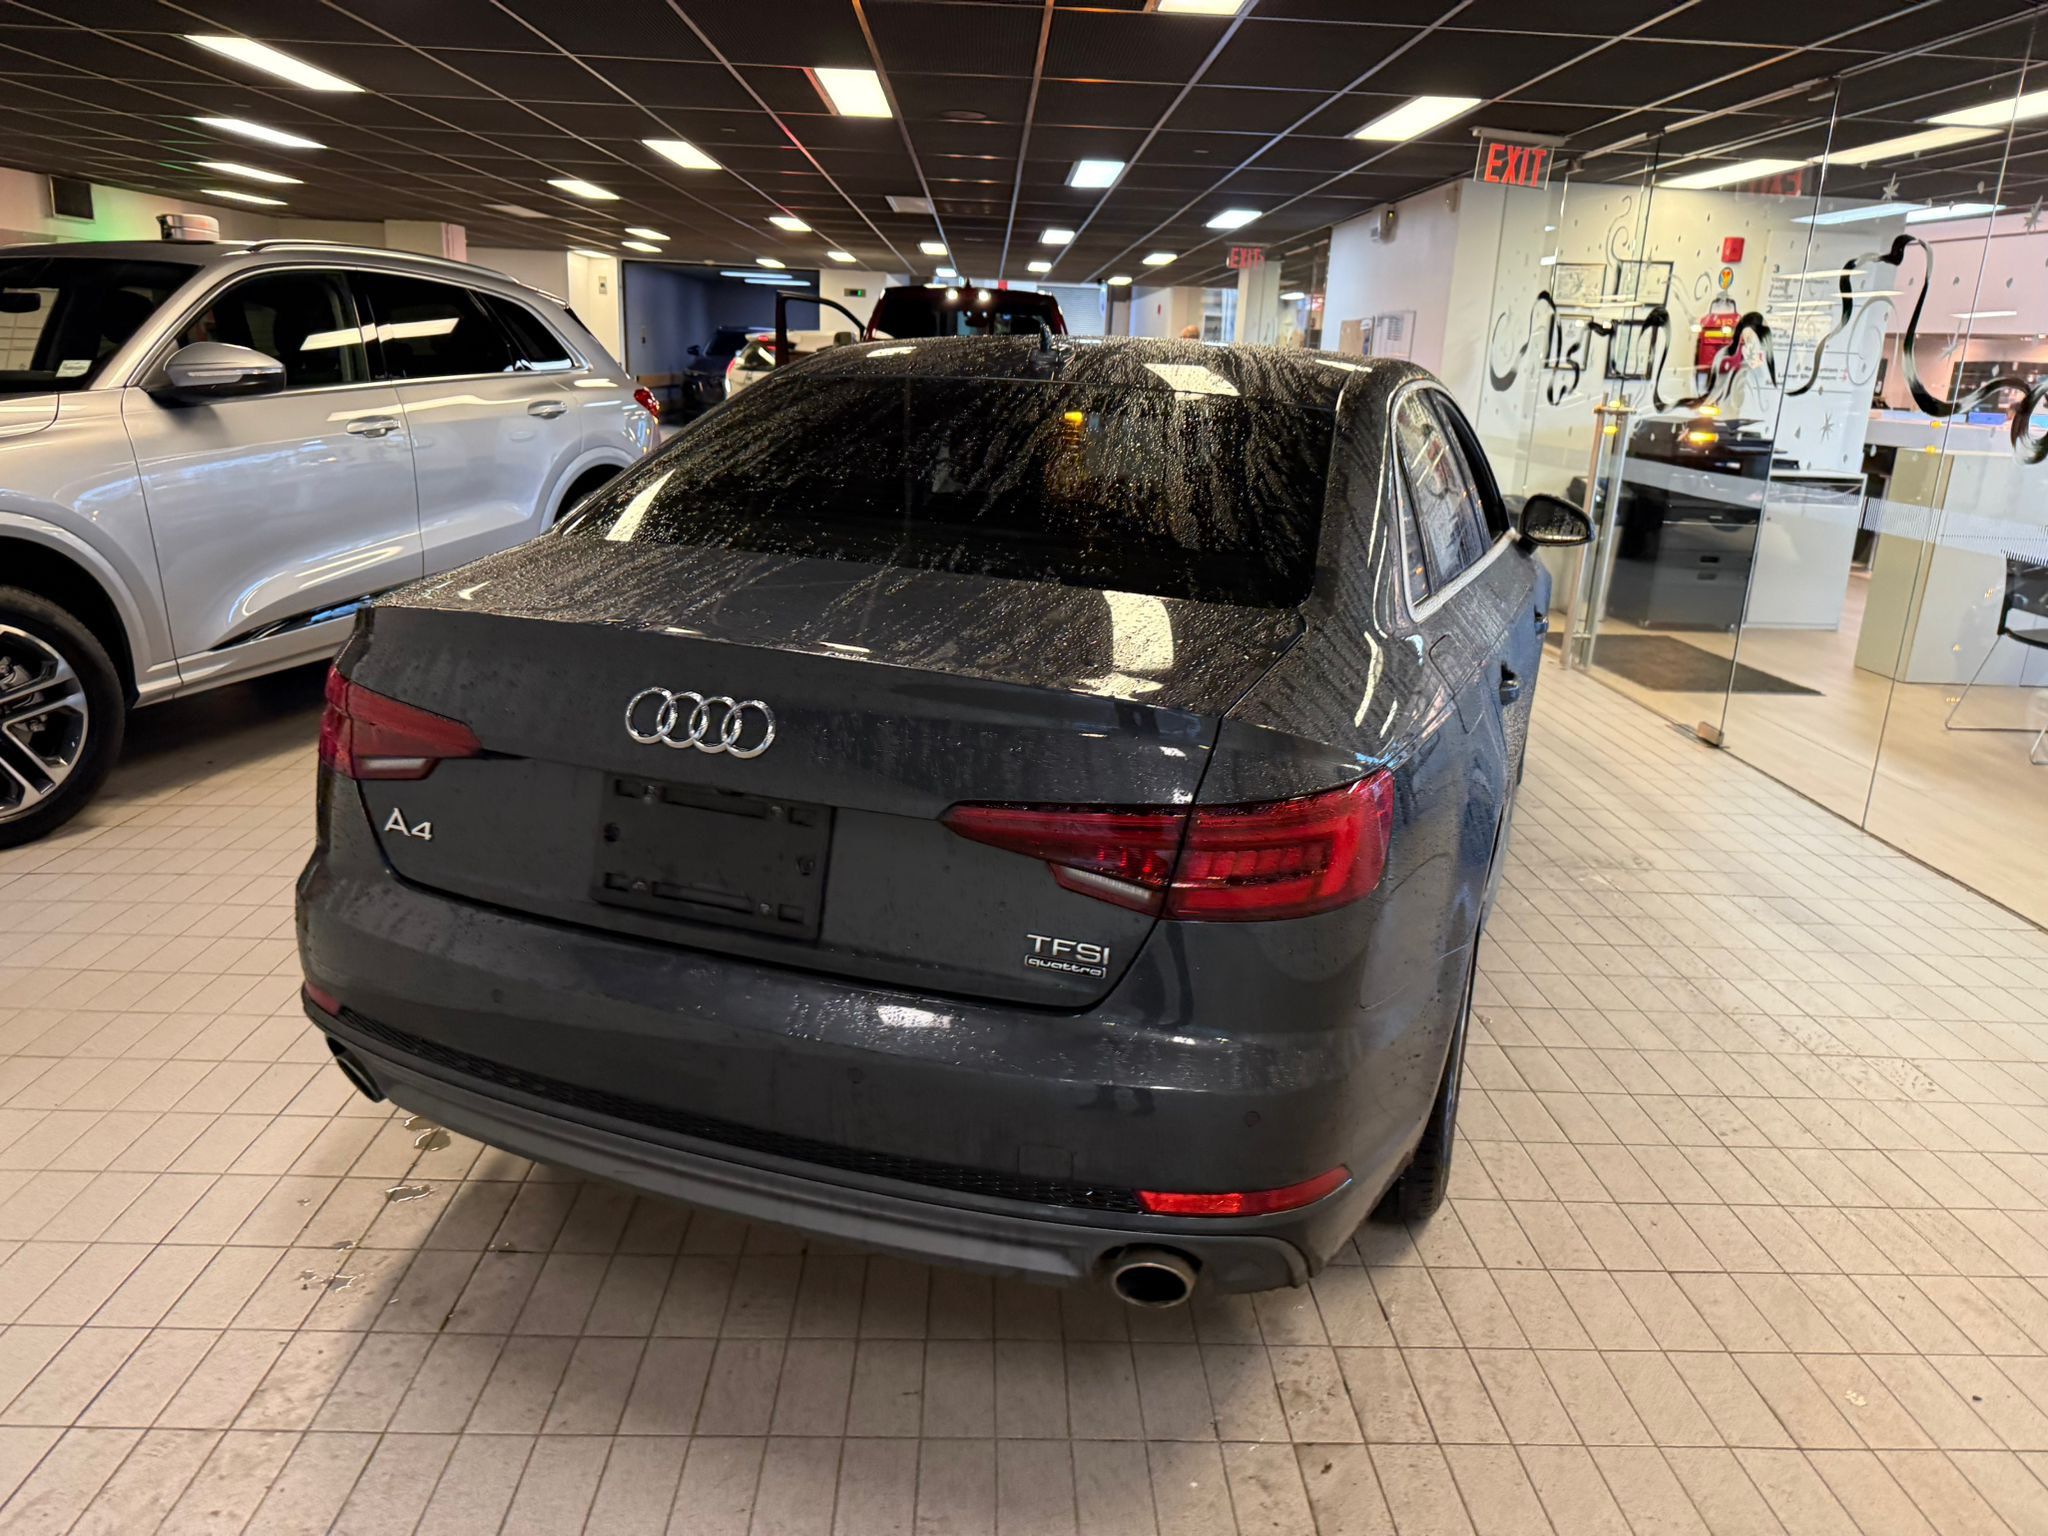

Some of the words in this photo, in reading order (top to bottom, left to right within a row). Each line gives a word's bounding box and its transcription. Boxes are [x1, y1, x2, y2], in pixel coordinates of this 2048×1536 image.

[1484, 143, 1547, 187] EXIT
[1231, 246, 1261, 271] EXIT
[1766, 305, 1773, 314] 2
[384, 807, 432, 840] A4
[1026, 934, 1110, 965] TFSI
[1027, 957, 1102, 977] quattro
